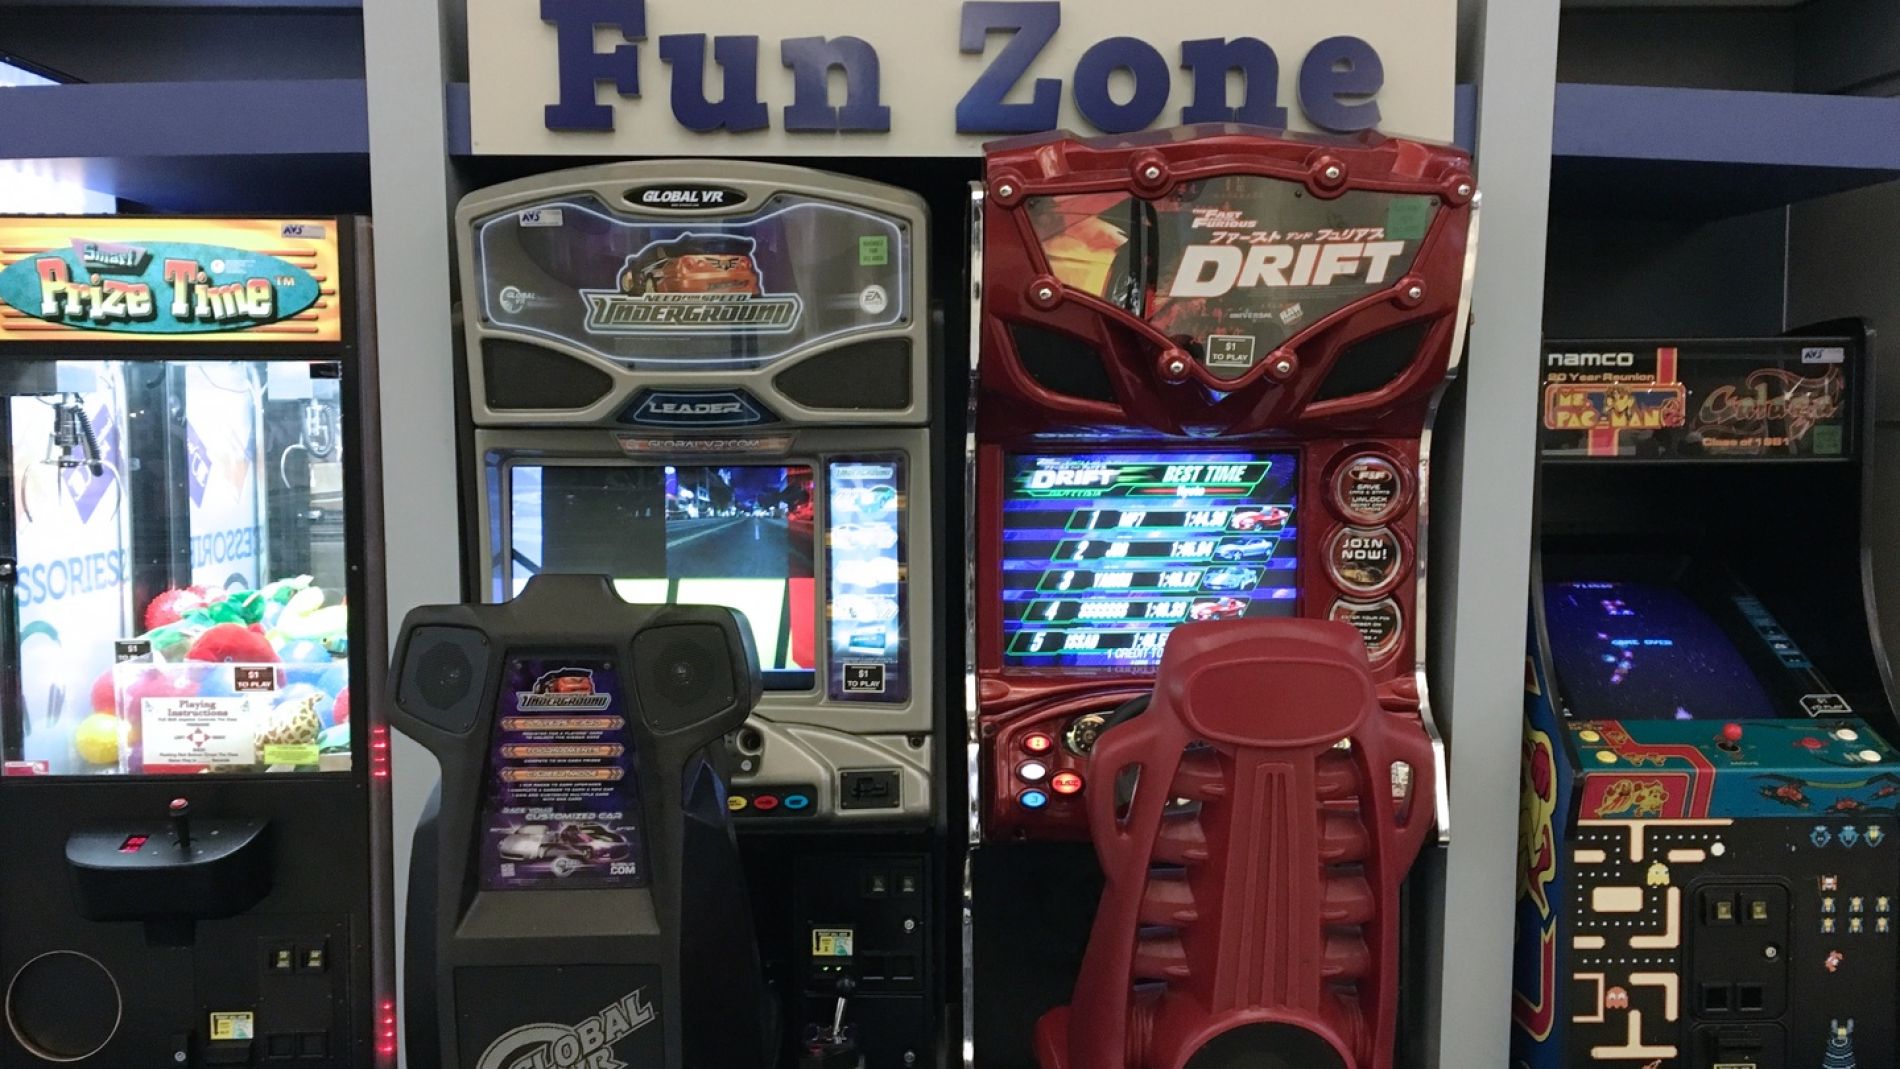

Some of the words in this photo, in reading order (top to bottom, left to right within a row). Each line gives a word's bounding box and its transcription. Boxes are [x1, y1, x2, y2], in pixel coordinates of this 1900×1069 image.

[539, 0, 892, 134] Fun
[956, 0, 1384, 135] Zone
[643, 190, 699, 202] GLOBAL
[702, 190, 724, 202] VR
[1204, 210, 1243, 219] FAST
[1210, 231, 1281, 244] ファースト
[1168, 240, 1405, 298] DRIFT
[35, 256, 152, 319] Prize
[164, 258, 273, 321] Time
[864, 290, 883, 302] EA
[592, 303, 796, 323] UNDERGROUND
[1225, 342, 1236, 351] $1
[1548, 353, 1634, 367] namco
[1571, 373, 1600, 382] Year
[1603, 373, 1655, 382] Reunion
[649, 402, 744, 414] LEADER
[1557, 410, 1662, 428] PAC-MAN
[1029, 469, 1120, 489] DRIFT
[1162, 465, 1204, 482] BEST
[1205, 465, 1248, 482] TIME
[1342, 538, 1383, 548] JOIN
[1073, 540, 1089, 560] 2
[1341, 549, 1387, 561] NOW!
[1060, 570, 1075, 590] 3
[1044, 601, 1061, 620] 4
[1030, 632, 1046, 652] 5
[1114, 647, 1148, 659] CREDIT
[1150, 647, 1165, 659] TO
[247, 671, 260, 679] $1
[858, 669, 869, 678] $1
[179, 700, 217, 710] Playing
[167, 709, 229, 718] Instructions
[525, 812, 596, 820] CUSTOMIZED
[598, 812, 623, 820] CAR
